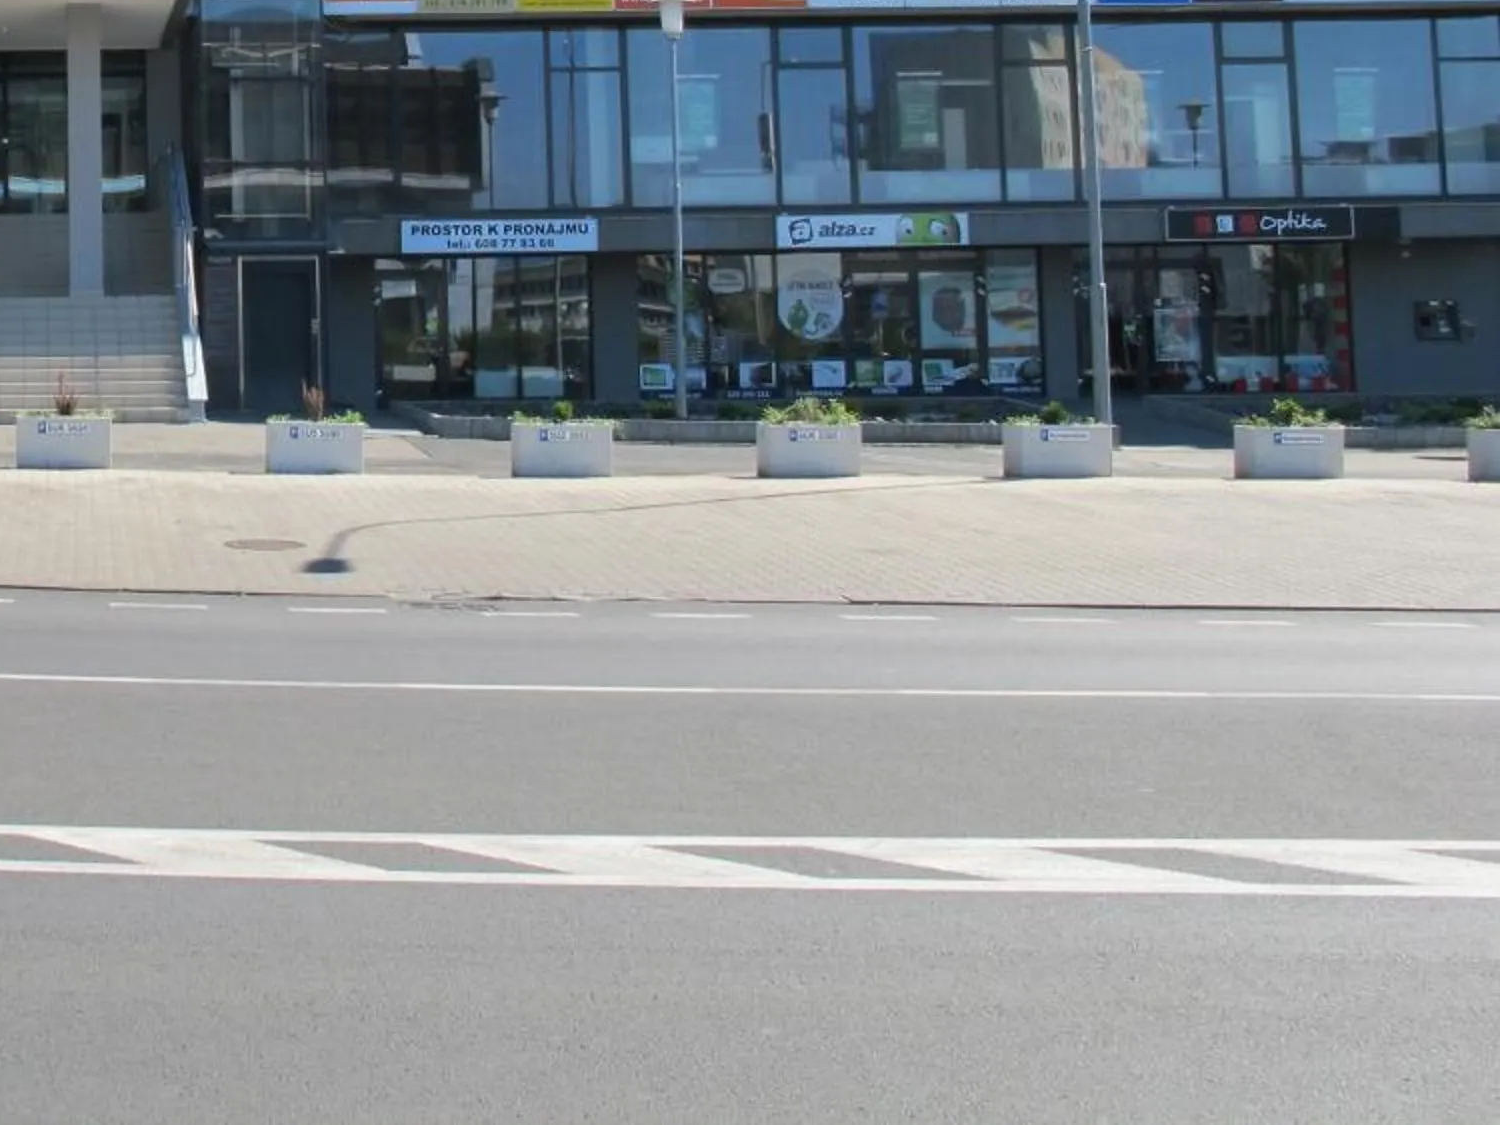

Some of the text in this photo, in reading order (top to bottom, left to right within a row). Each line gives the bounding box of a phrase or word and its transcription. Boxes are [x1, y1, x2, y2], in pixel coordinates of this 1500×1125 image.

[411, 224, 483, 236] PROSTOR
[487, 223, 499, 236] K
[818, 220, 877, 237] alza.cz
[1260, 210, 1327, 235] Optika
[501, 238, 516, 248] 77
